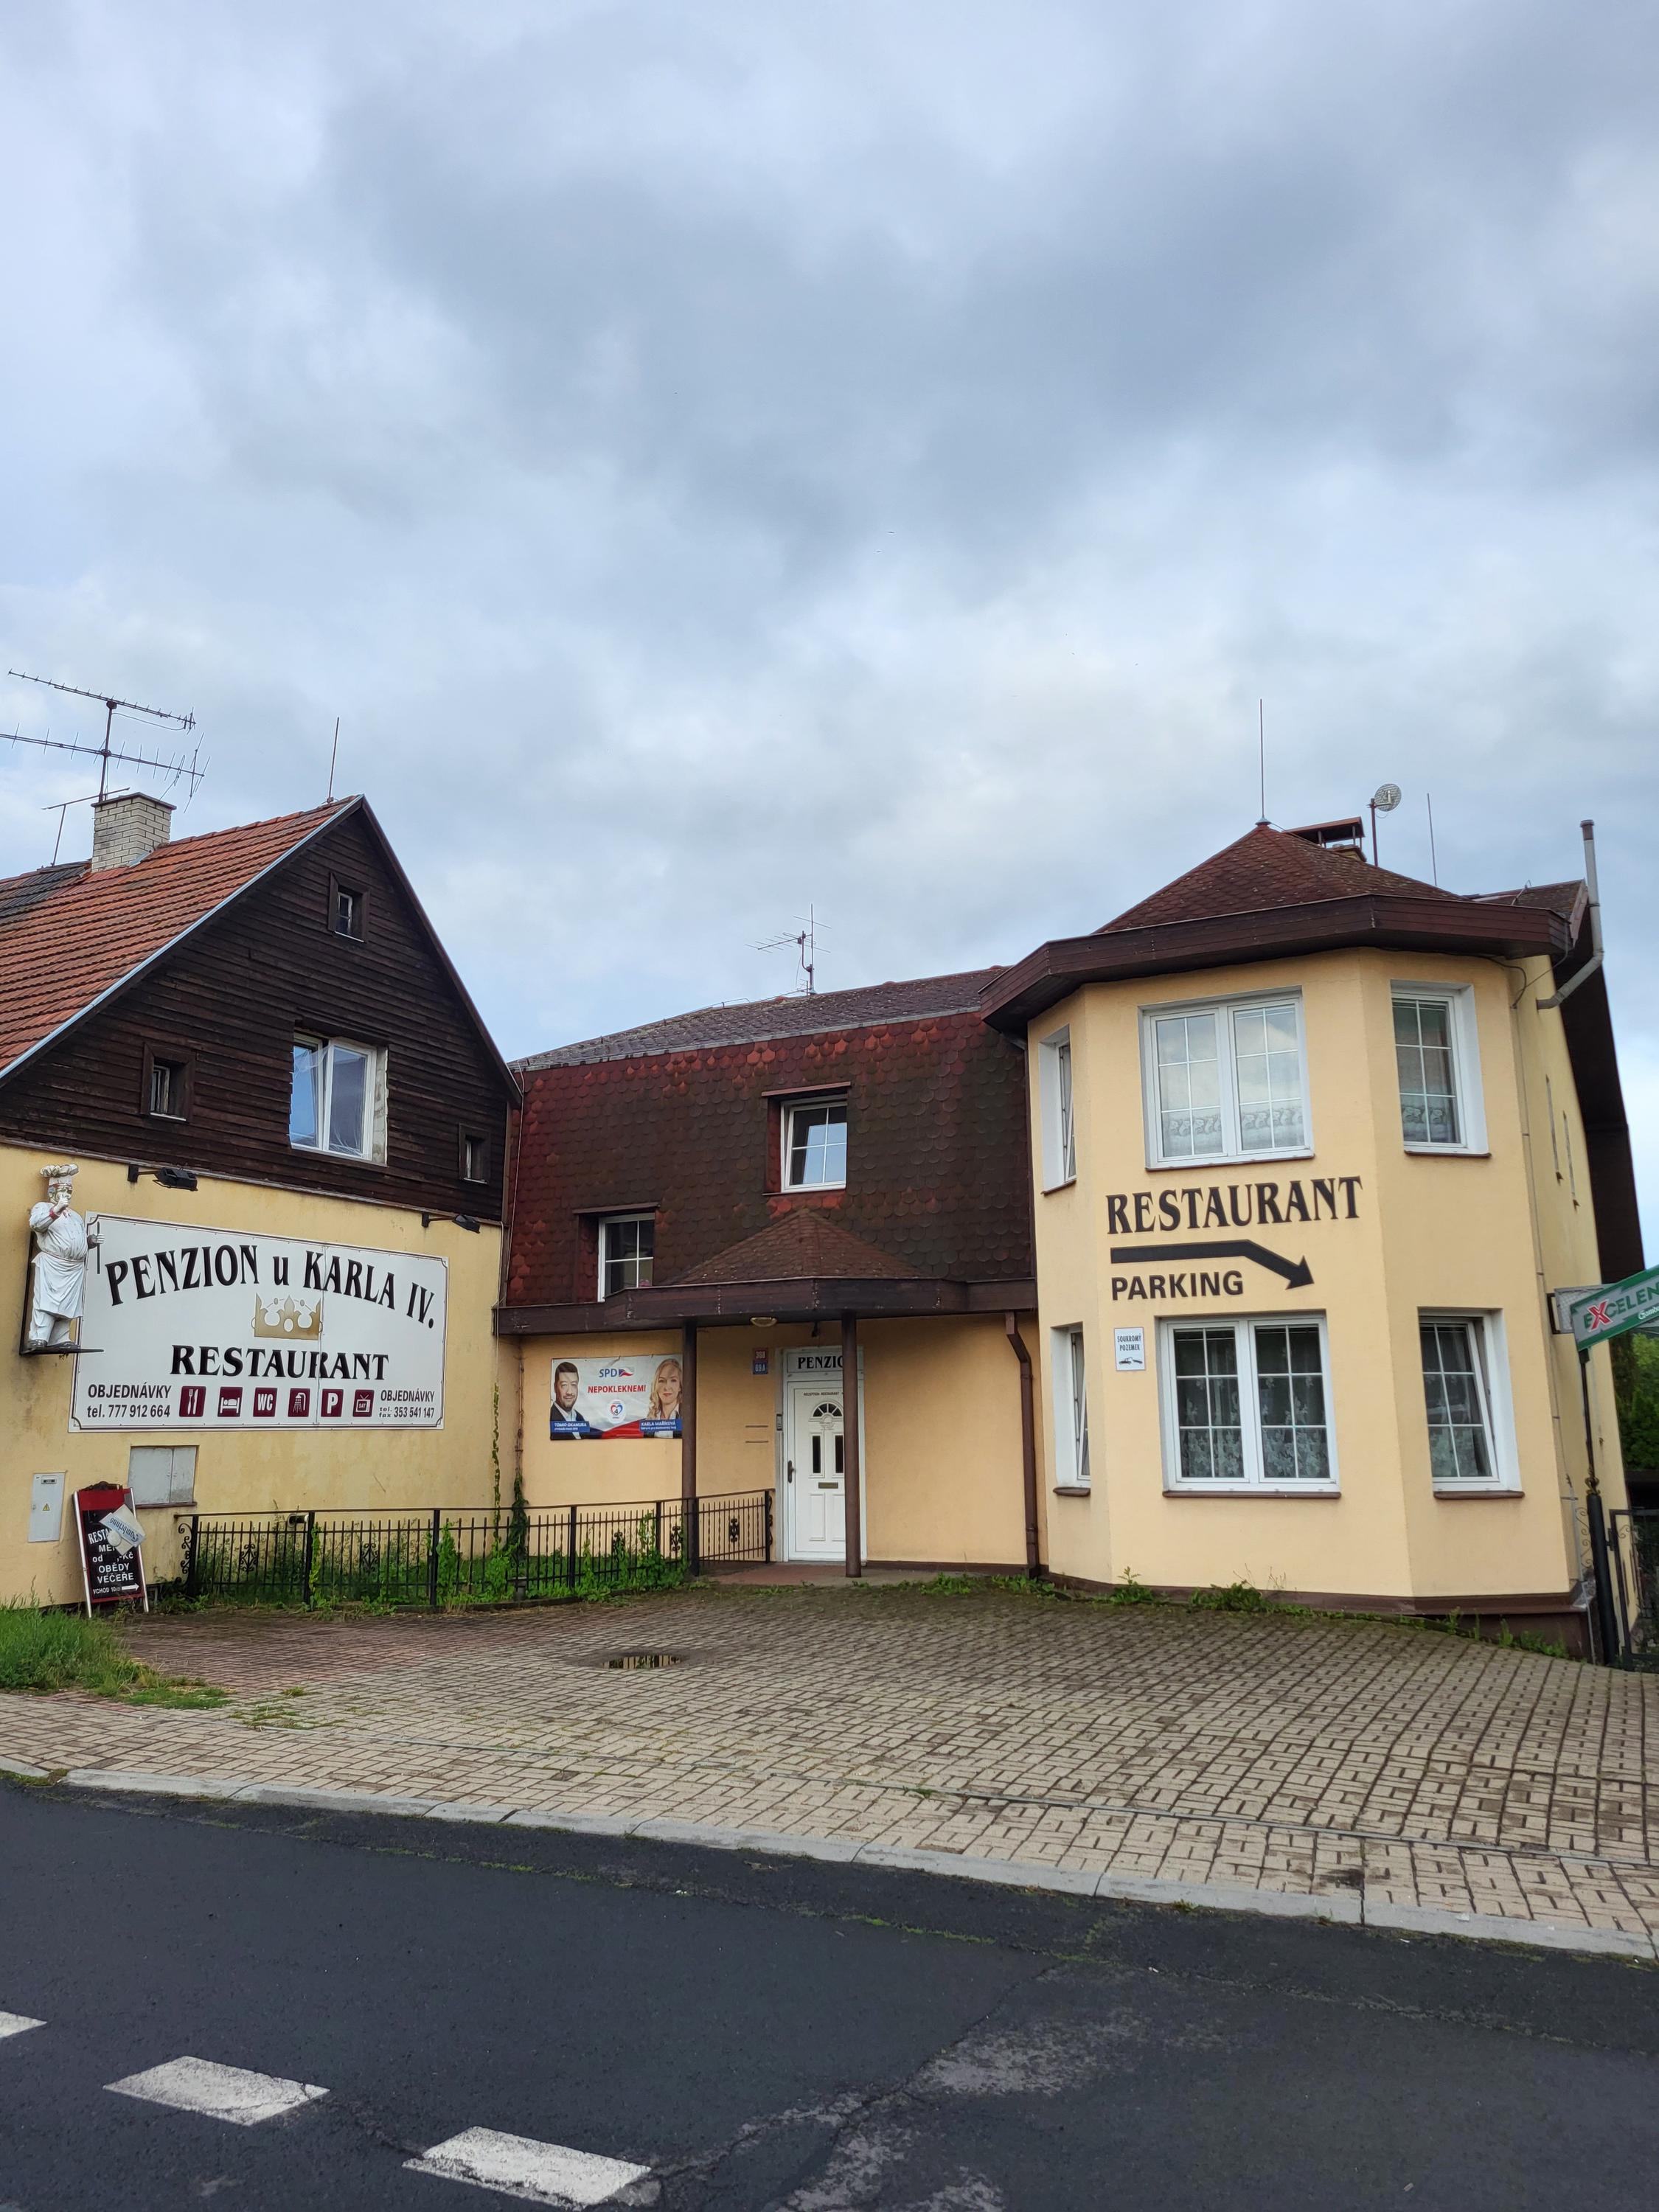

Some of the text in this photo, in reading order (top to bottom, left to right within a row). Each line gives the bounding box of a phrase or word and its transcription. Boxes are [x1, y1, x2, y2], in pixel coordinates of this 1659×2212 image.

[1105, 1175, 1363, 1235] RESTAURANT
[105, 1245, 435, 1329] PENZION u KARLA IV.
[1110, 1270, 1244, 1301] PARKING
[1119, 1343, 1141, 1352] POZEMEK
[170, 1344, 389, 1380] RESTAURANT
[797, 1355, 844, 1370] PENZIO
[598, 1368, 618, 1378] SPD
[88, 1382, 172, 1399] OBJEDNÁVKY
[380, 1388, 435, 1402] OBJEDNÁVKY
[257, 1394, 274, 1411] WC
[327, 1392, 339, 1414] P
[87, 1403, 170, 1418] tel. 777 912 664
[394, 1406, 408, 1418] 353
[409, 1407, 422, 1419] 541
[423, 1407, 435, 1419] 147
[92, 1554, 103, 1562] od
[98, 1562, 130, 1573] OBĚDY
[97, 1571, 134, 1585] VEČEŘE
